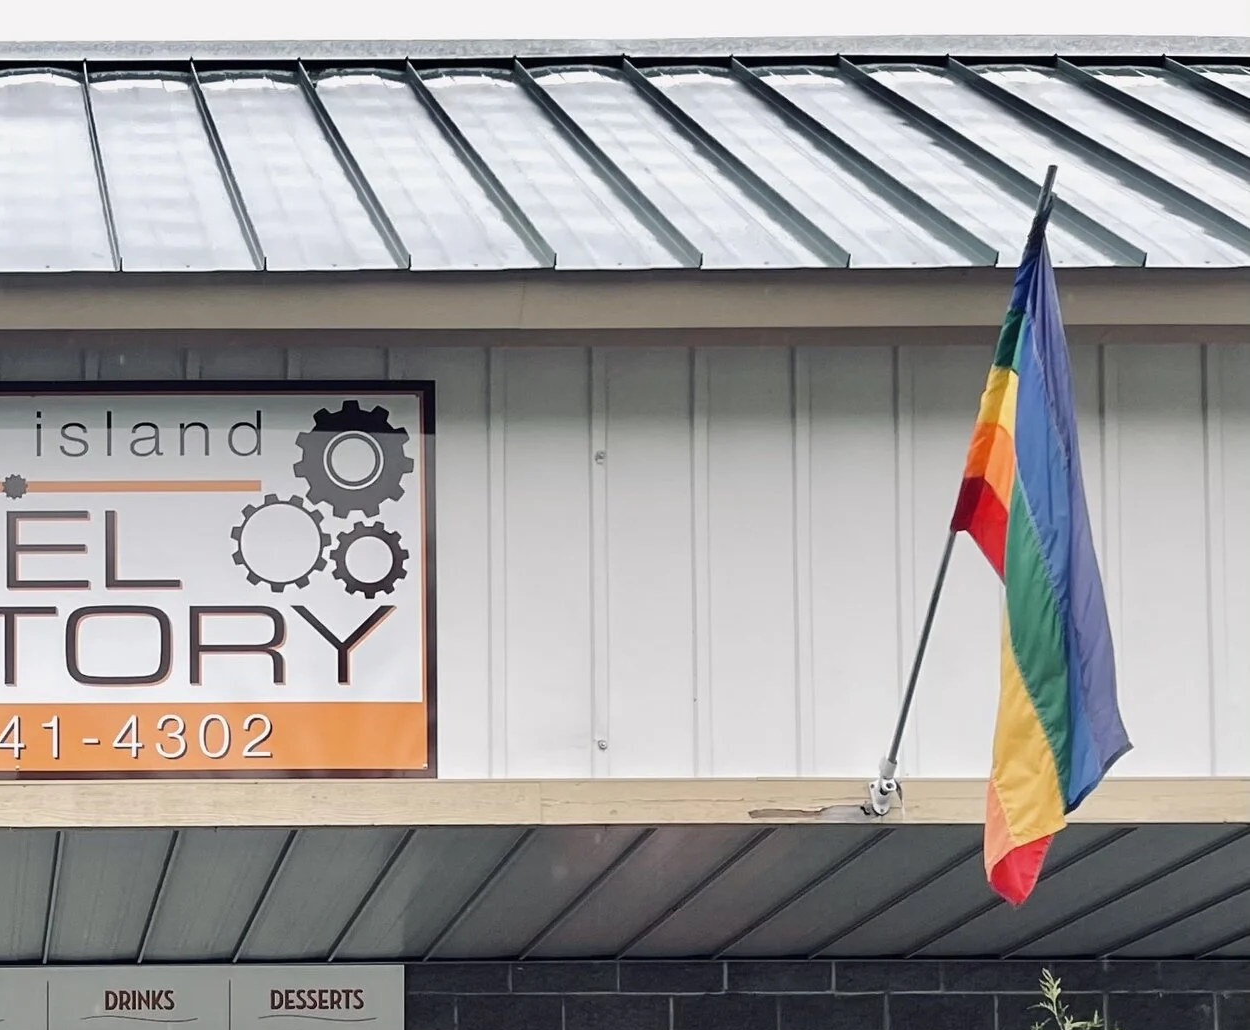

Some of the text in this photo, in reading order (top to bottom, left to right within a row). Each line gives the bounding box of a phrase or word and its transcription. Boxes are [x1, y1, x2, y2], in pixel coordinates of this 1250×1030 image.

[35, 410, 262, 458] island
[105, 990, 175, 1011] DRINKS
[271, 990, 365, 1010] DESSERTS
